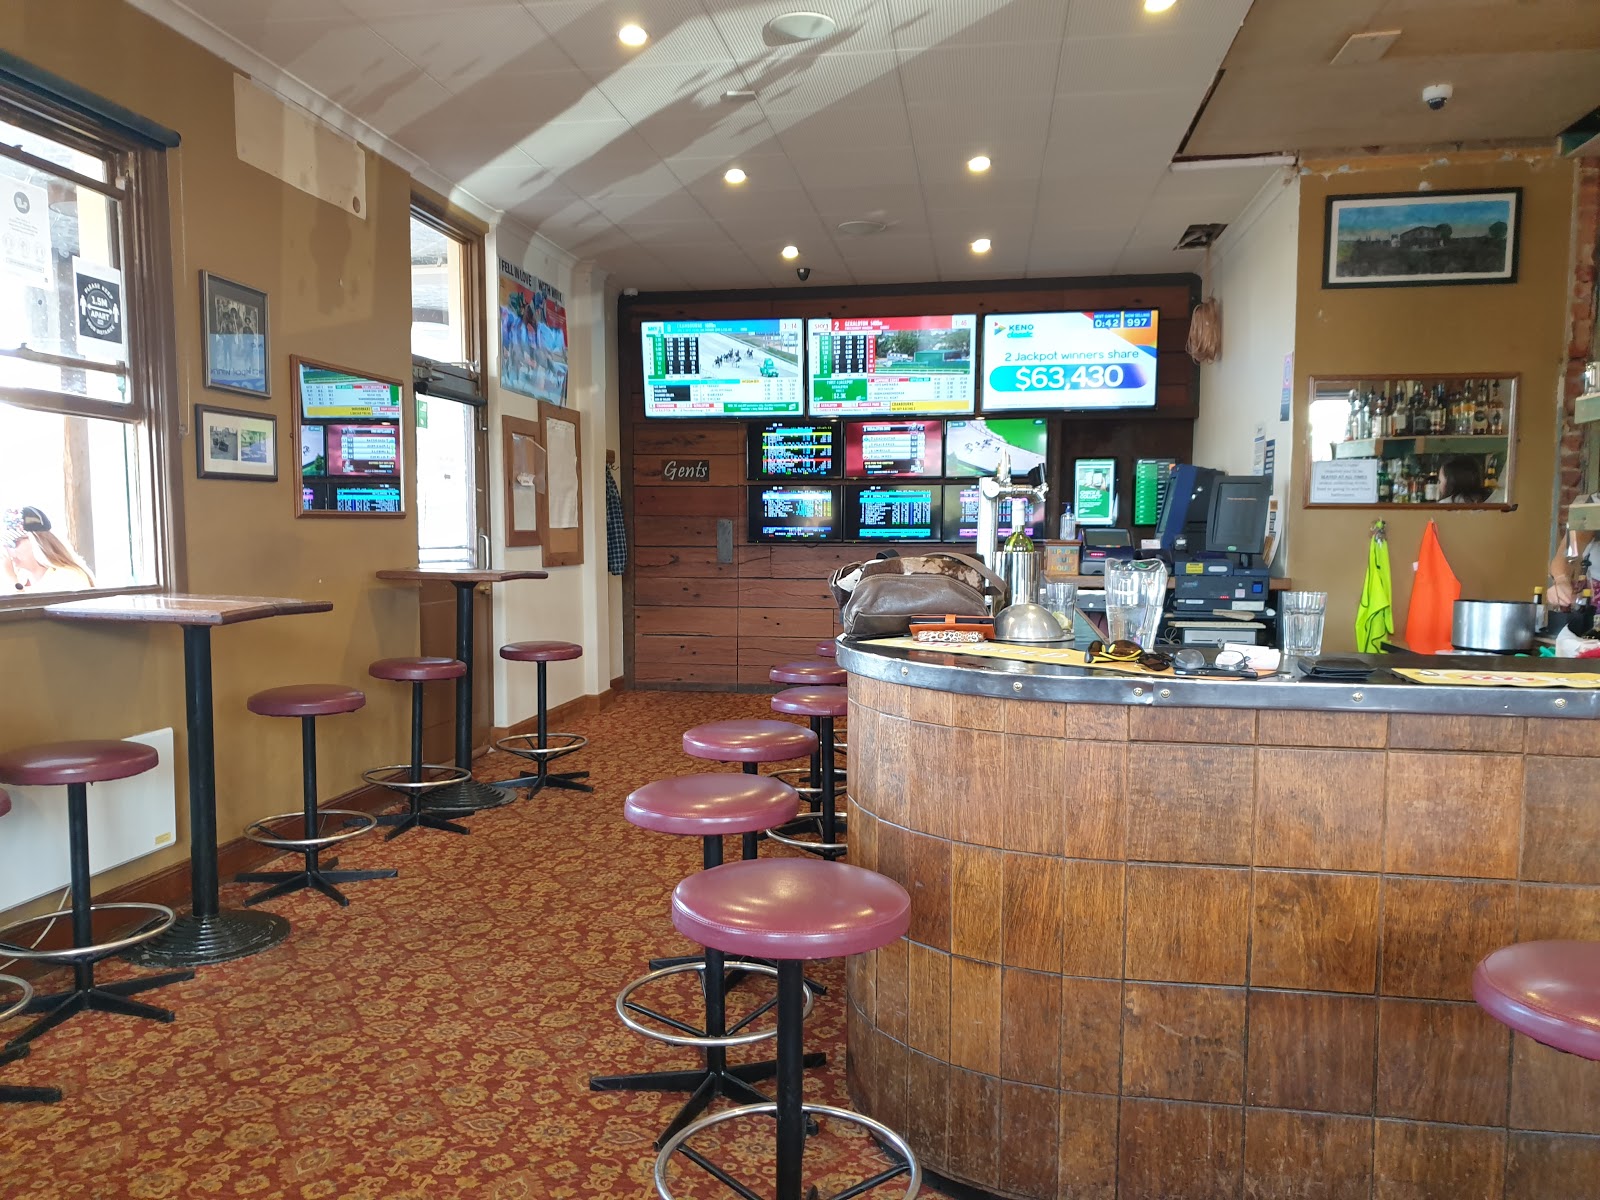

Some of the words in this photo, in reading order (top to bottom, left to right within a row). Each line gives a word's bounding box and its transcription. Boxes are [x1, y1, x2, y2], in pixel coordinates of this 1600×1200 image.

[502, 259, 514, 276] FELL
[514, 266, 520, 280] IN
[520, 269, 532, 287] LOVE
[537, 279, 551, 297] WITH
[84, 283, 100, 294] PLEASE
[101, 285, 113, 299] KEEP
[91, 295, 108, 307] 1.5M
[90, 310, 110, 321] APART
[834, 321, 840, 330] 2
[1008, 323, 1034, 332] KENO
[1095, 318, 1119, 328] 0:42
[1127, 318, 1147, 327] 997
[1005, 353, 1012, 362] 2
[1014, 350, 1058, 362] Jackpot
[1061, 351, 1104, 360] winners
[1107, 349, 1139, 359] share
[1015, 364, 1124, 391] $63,430
[664, 460, 708, 480] Gents
